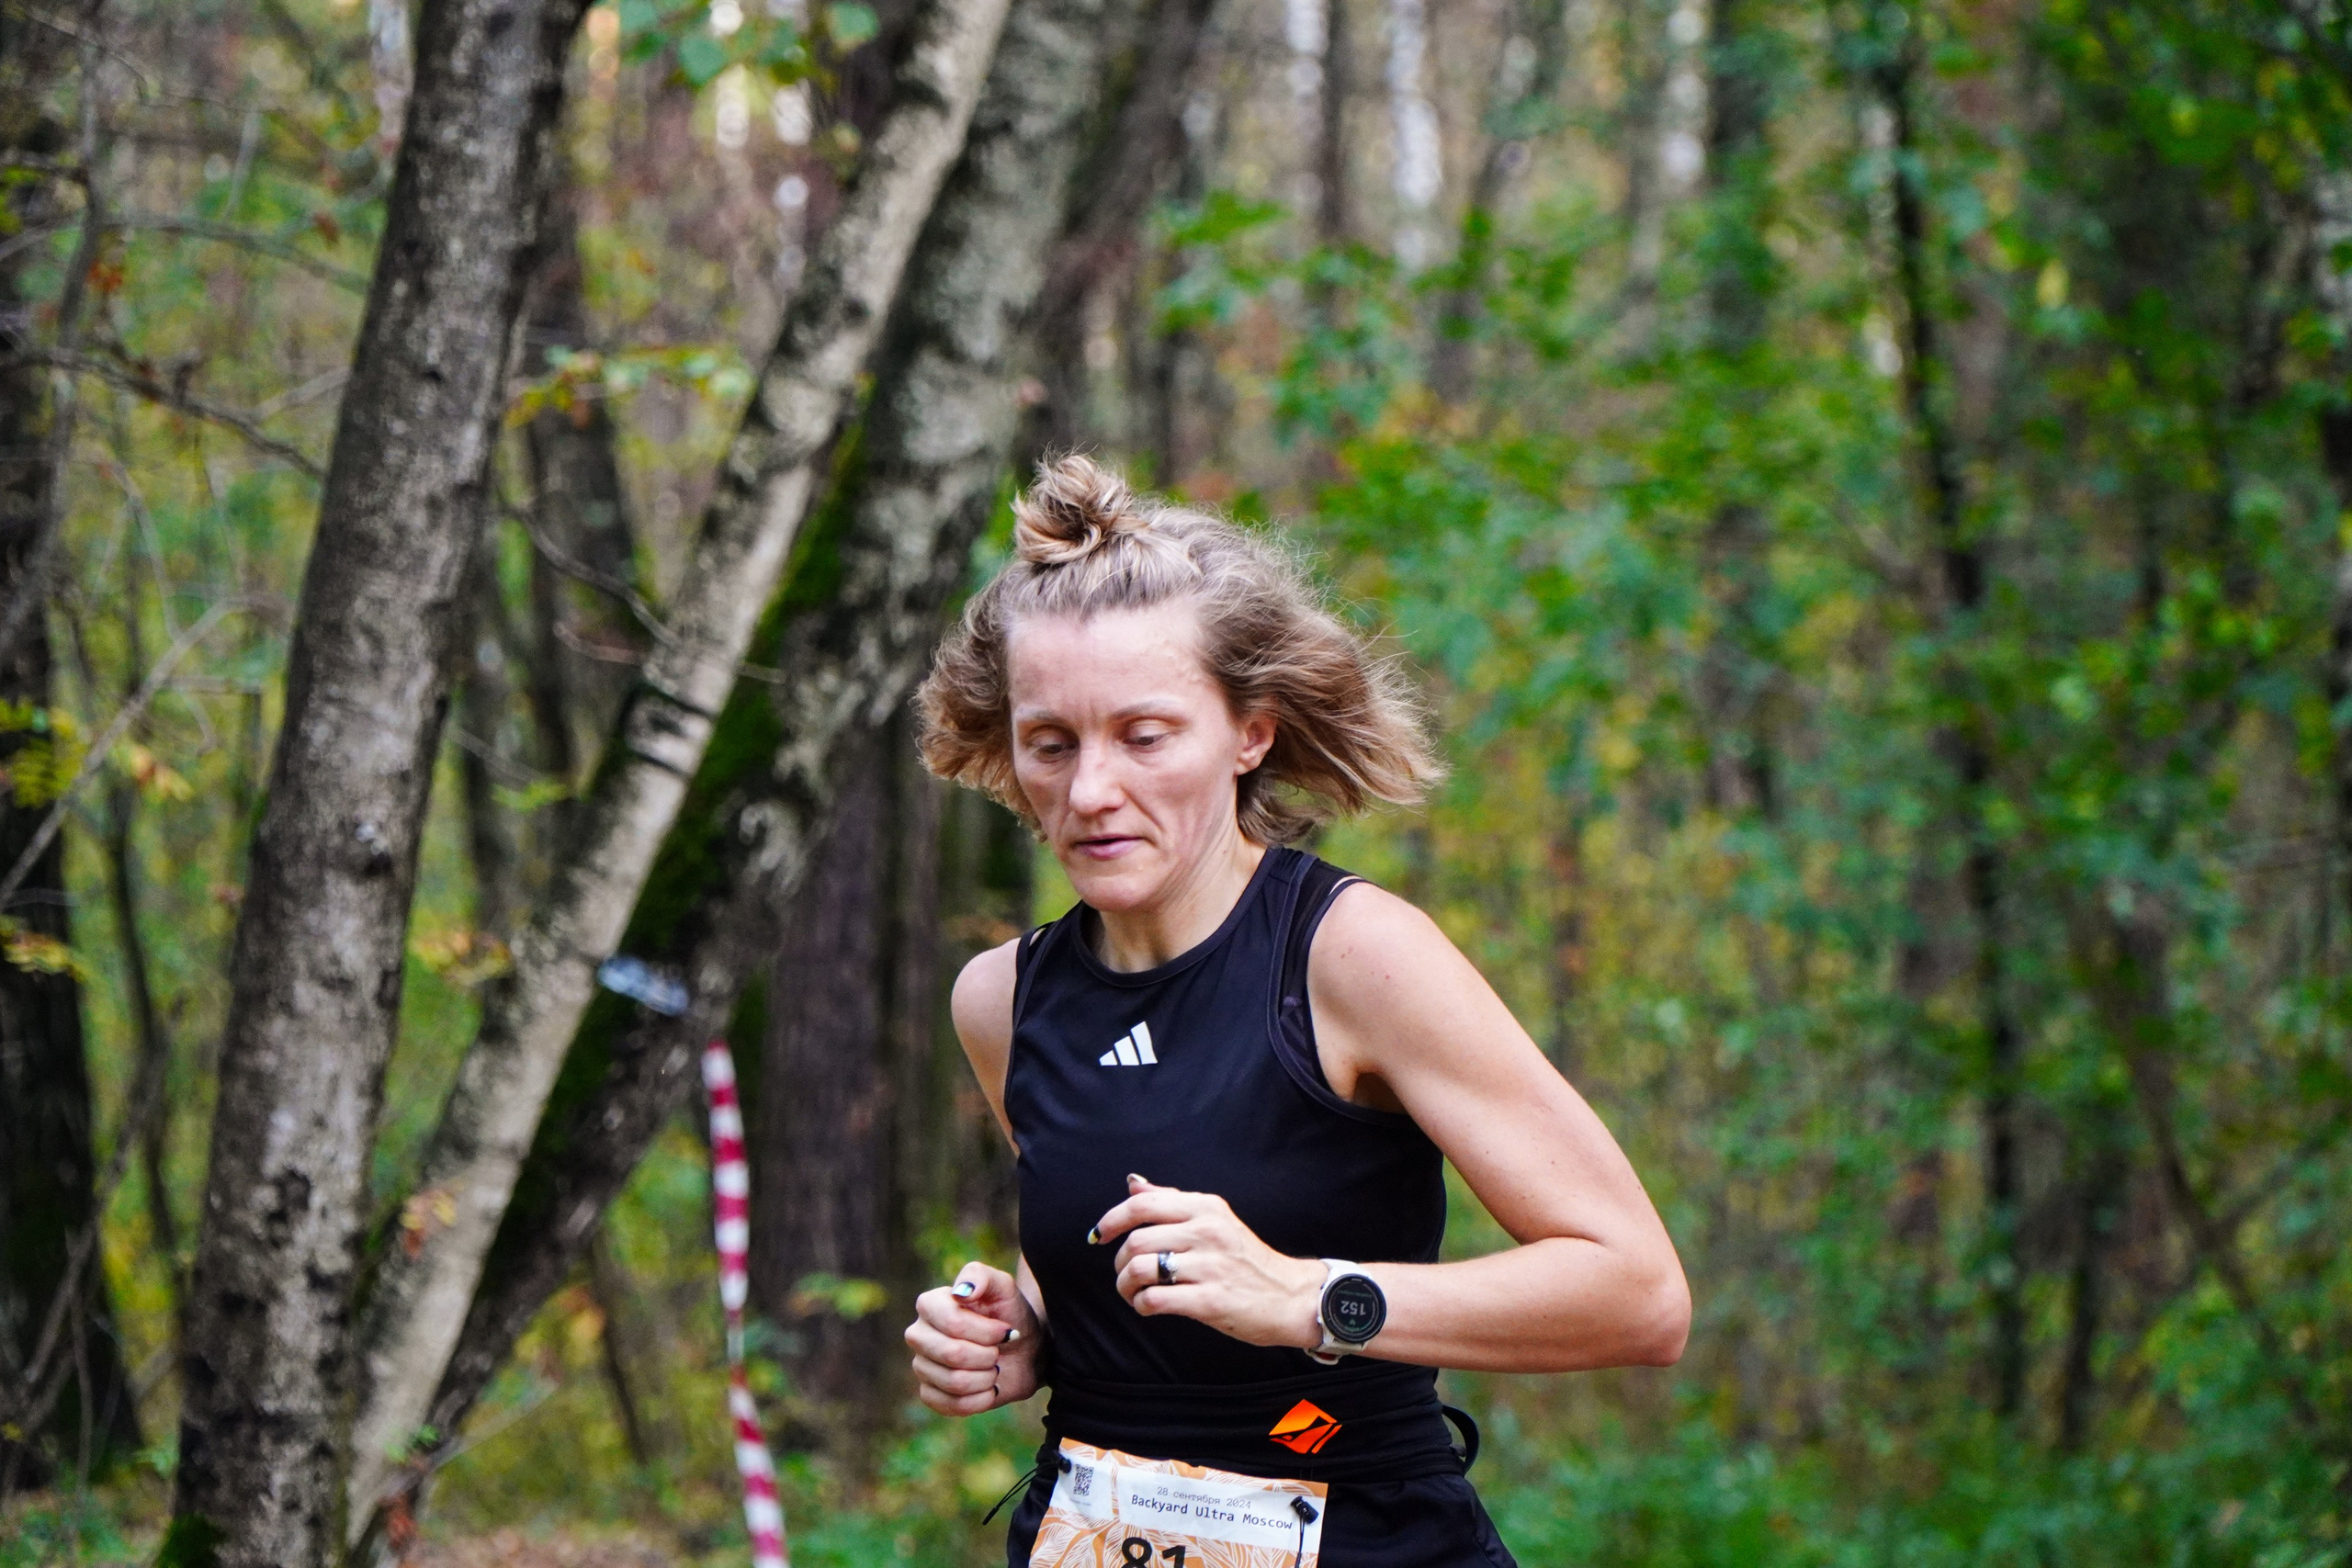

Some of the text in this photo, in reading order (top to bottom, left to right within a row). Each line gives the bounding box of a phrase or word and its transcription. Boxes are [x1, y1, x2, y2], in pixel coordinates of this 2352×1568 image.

[1340, 1300, 1366, 1316] 152
[1157, 1486, 1251, 1509] 28 сентября 2024
[1131, 1495, 1293, 1529] Backyard Ultra Moscow
